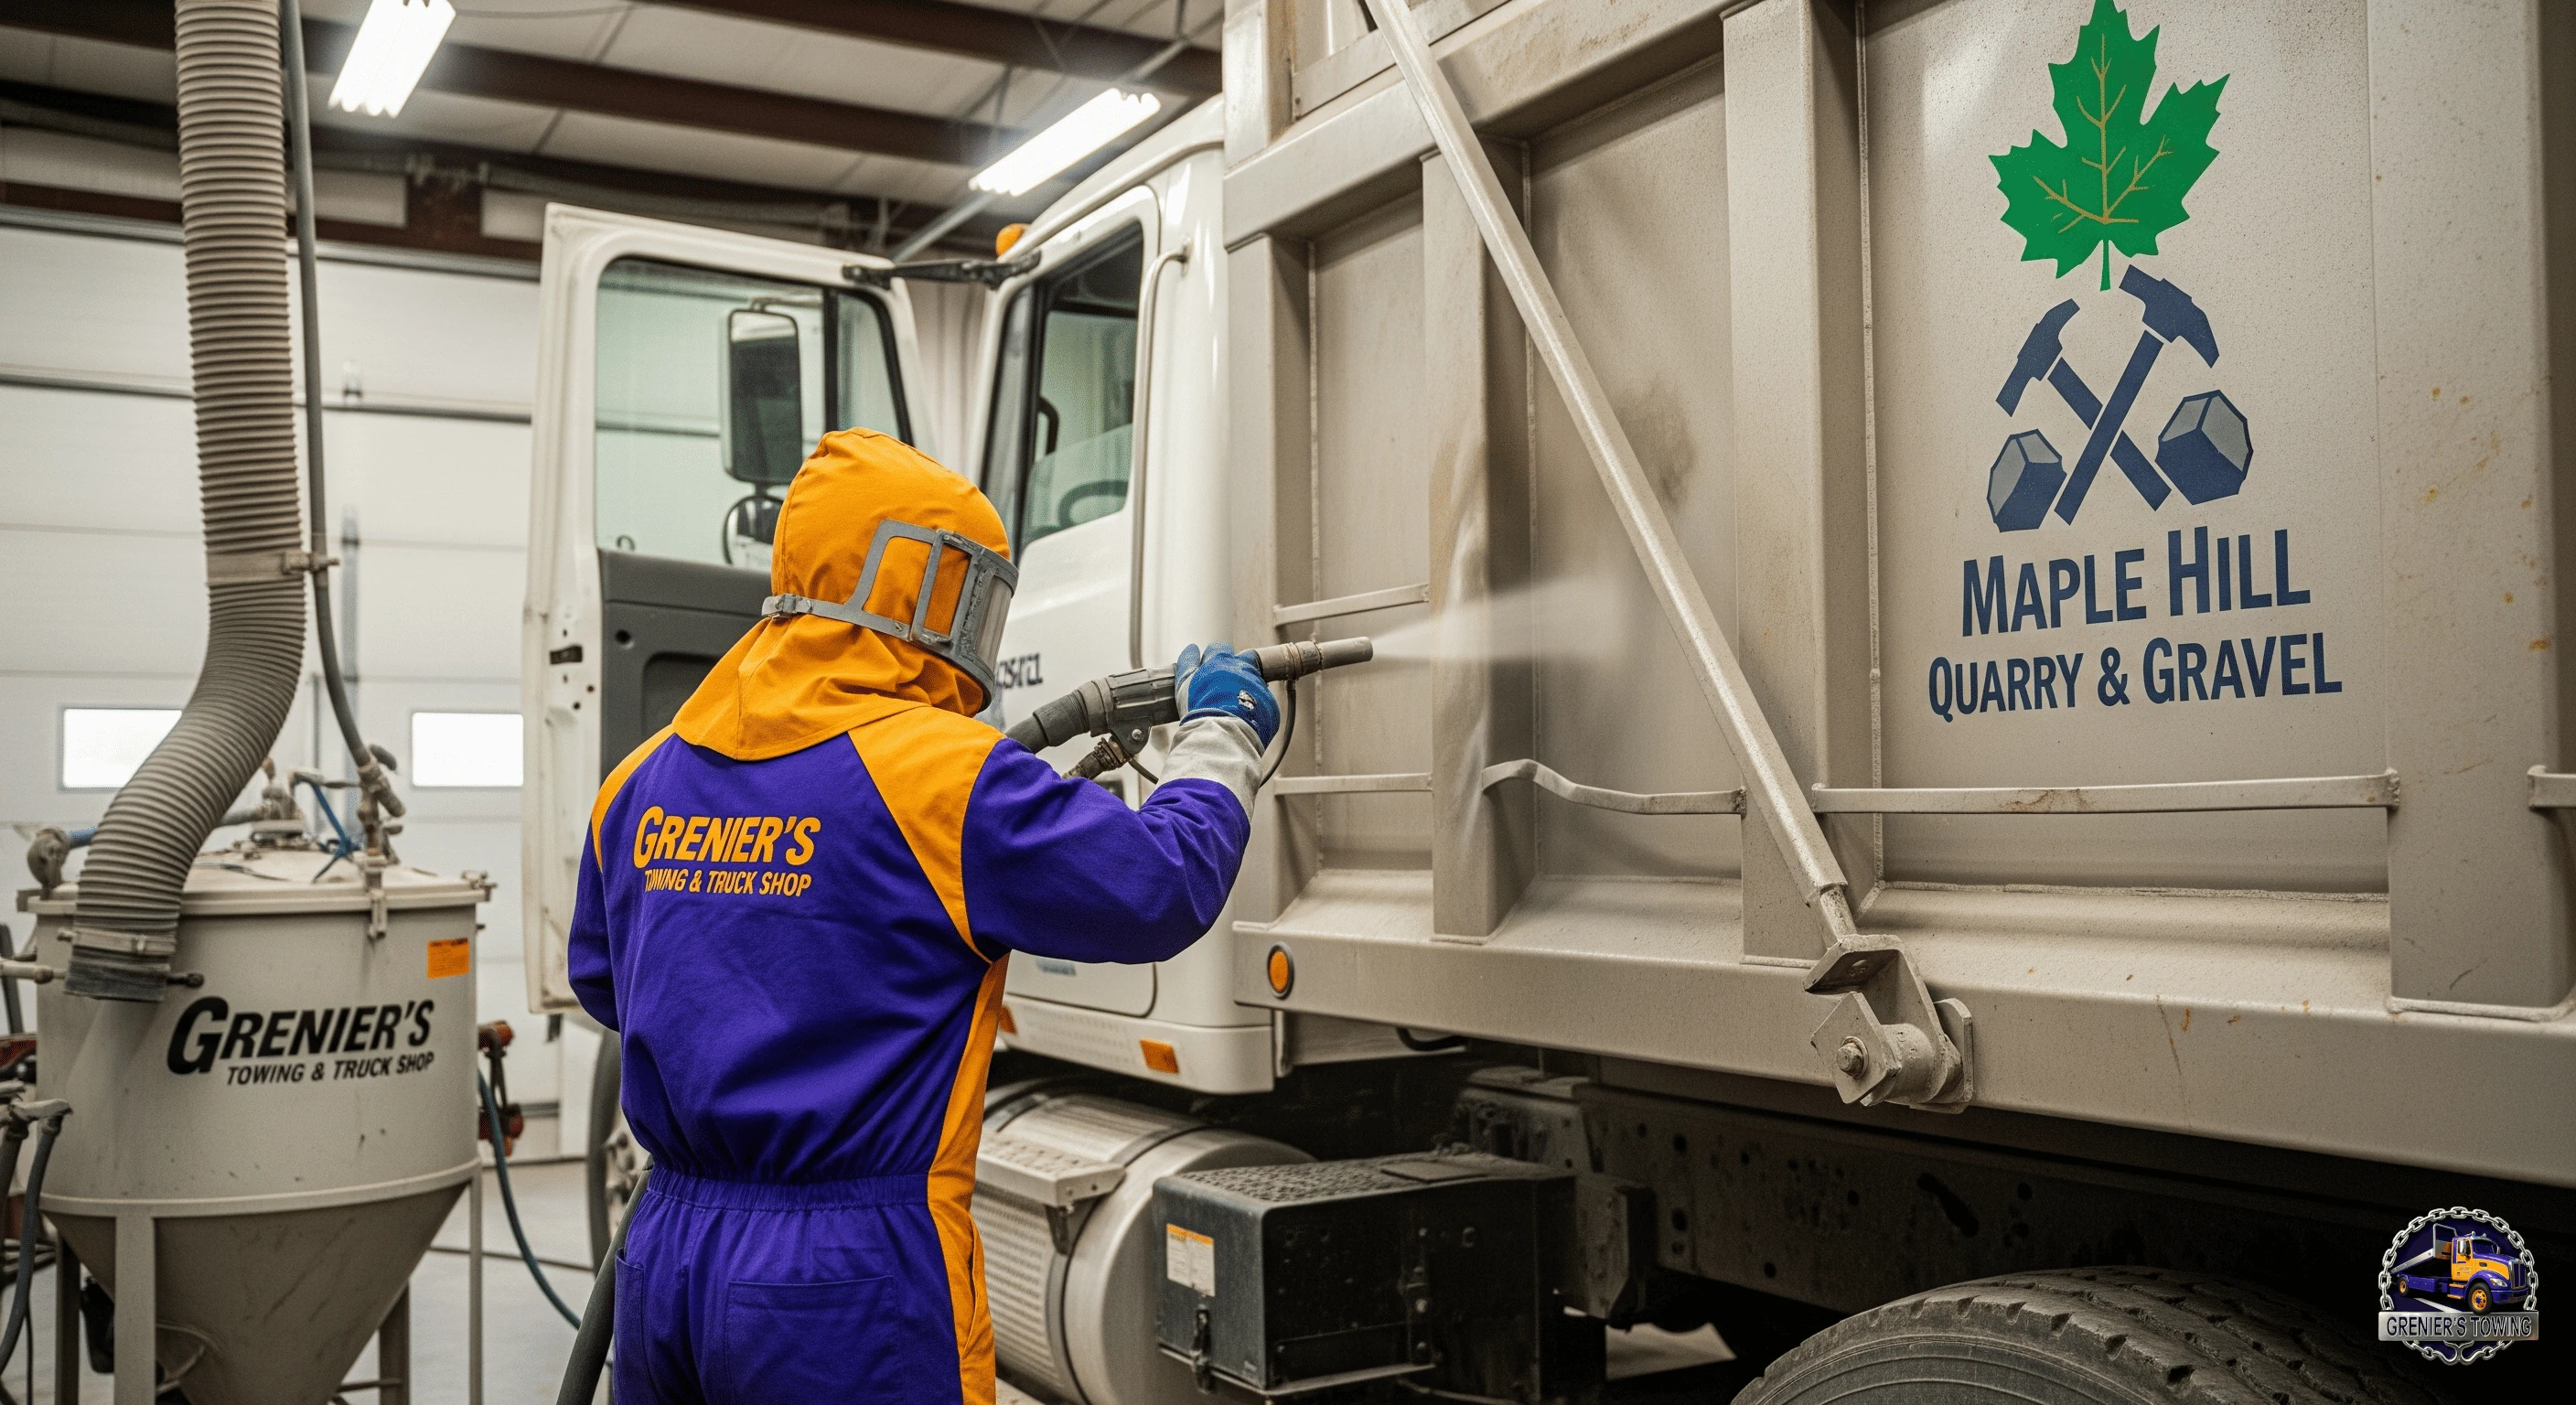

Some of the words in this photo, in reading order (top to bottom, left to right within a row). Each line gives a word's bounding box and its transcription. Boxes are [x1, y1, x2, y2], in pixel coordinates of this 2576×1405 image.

[1962, 548, 2147, 637] MAPLE
[2168, 526, 2311, 617] HILL
[1928, 653, 2084, 723] QUARRY
[2098, 647, 2131, 707] &
[2143, 632, 2343, 704] GRAVEL
[633, 806, 821, 868] GRENIER'S
[689, 870, 703, 893] &
[706, 871, 757, 895] TRUCK
[758, 872, 812, 896] SHOP
[166, 995, 435, 1076] GRENIER'S
[227, 1063, 305, 1086] TOWING
[311, 1062, 325, 1080] &
[333, 1056, 393, 1080] TRUCK
[396, 1051, 435, 1074] SHOP
